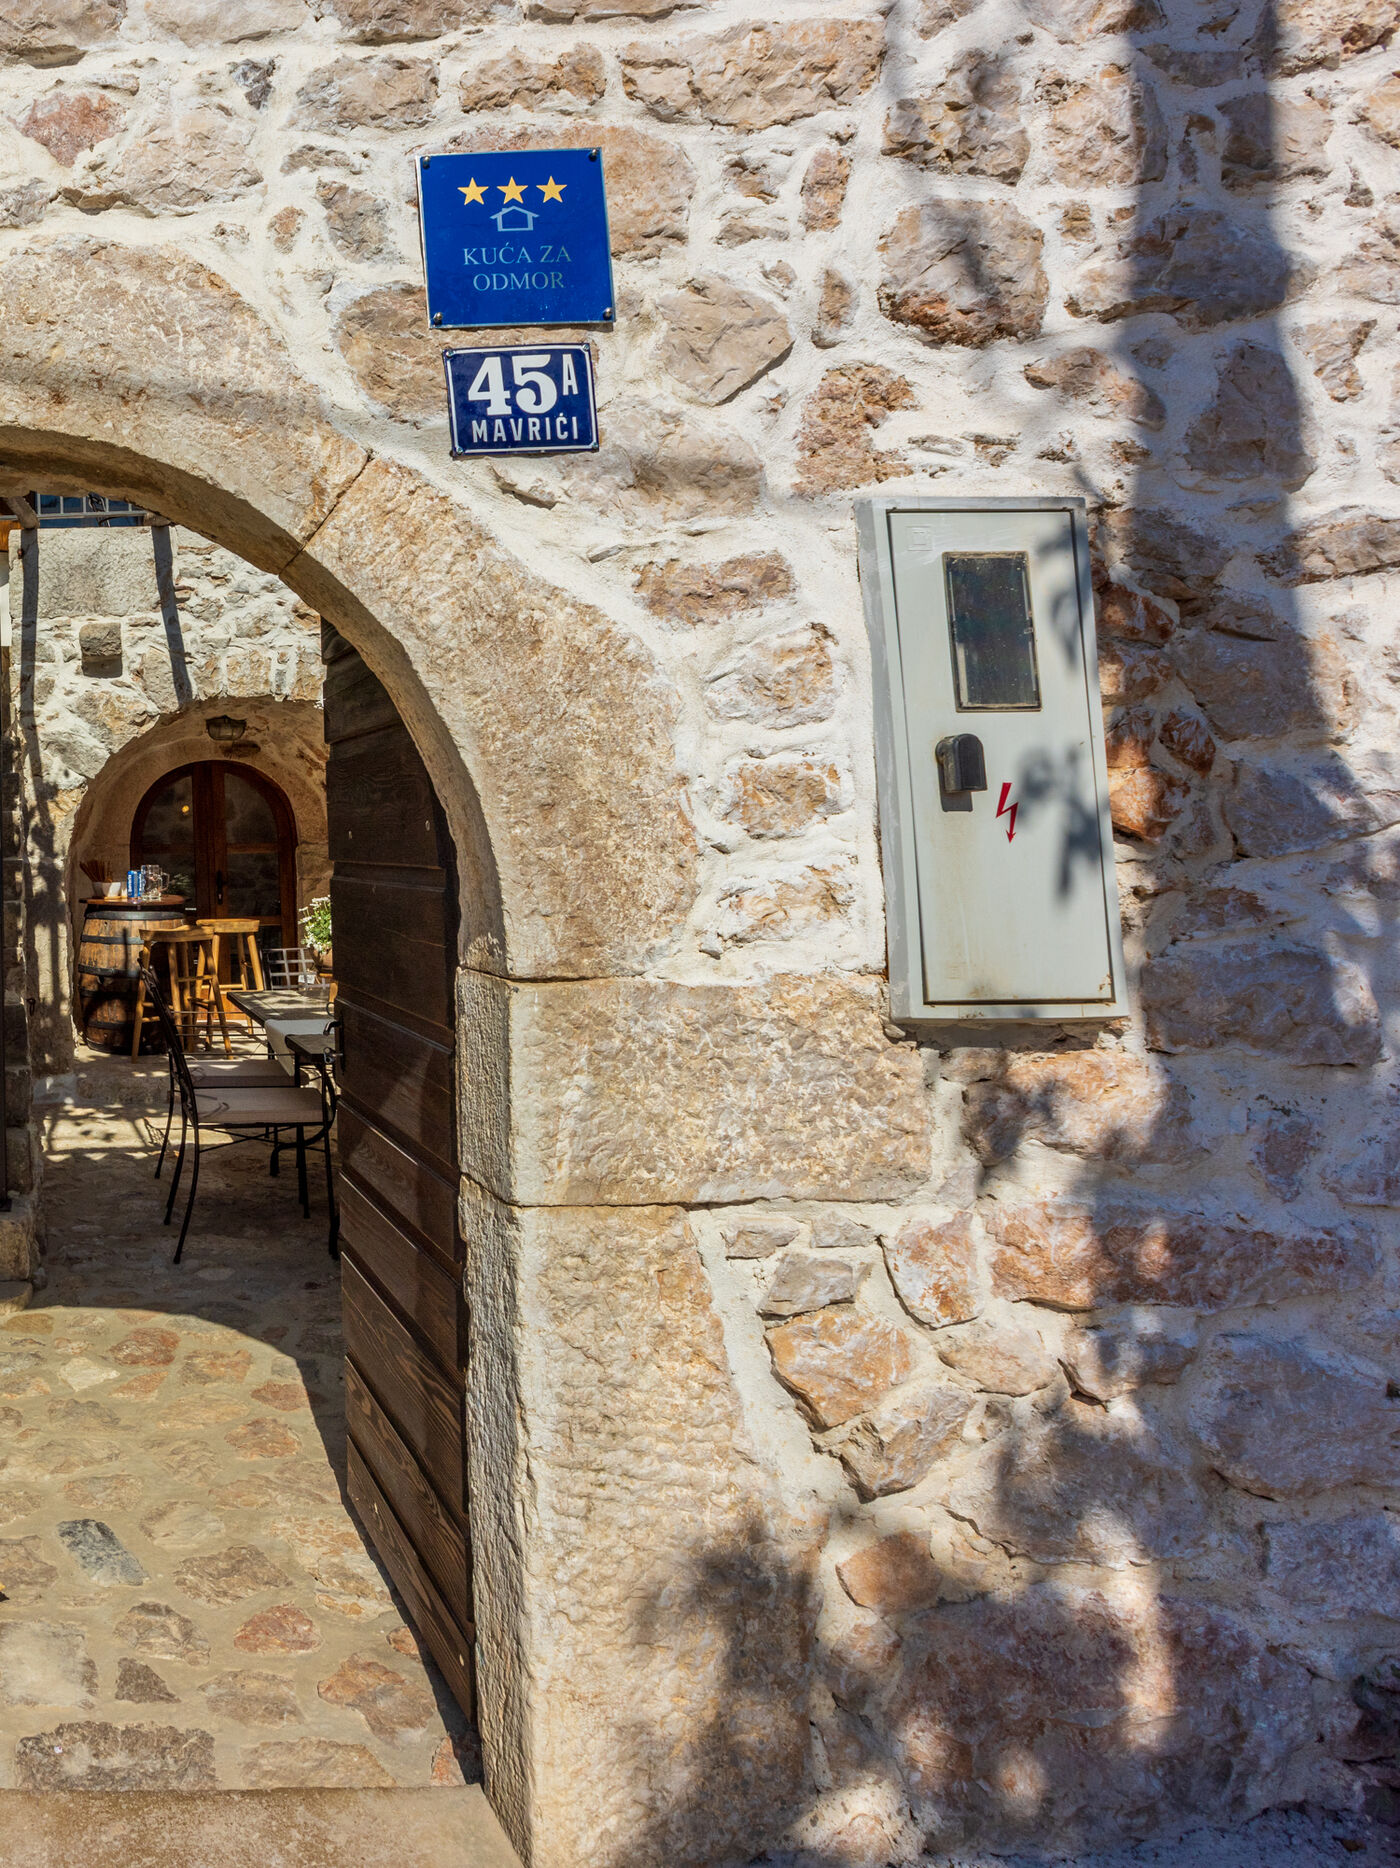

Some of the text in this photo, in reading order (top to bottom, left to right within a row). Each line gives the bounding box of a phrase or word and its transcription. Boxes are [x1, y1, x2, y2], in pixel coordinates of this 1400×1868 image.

[463, 242, 572, 265] KUĆA ZA
[473, 271, 565, 292] ODMOR
[471, 412, 579, 443] MAVRIĆI
